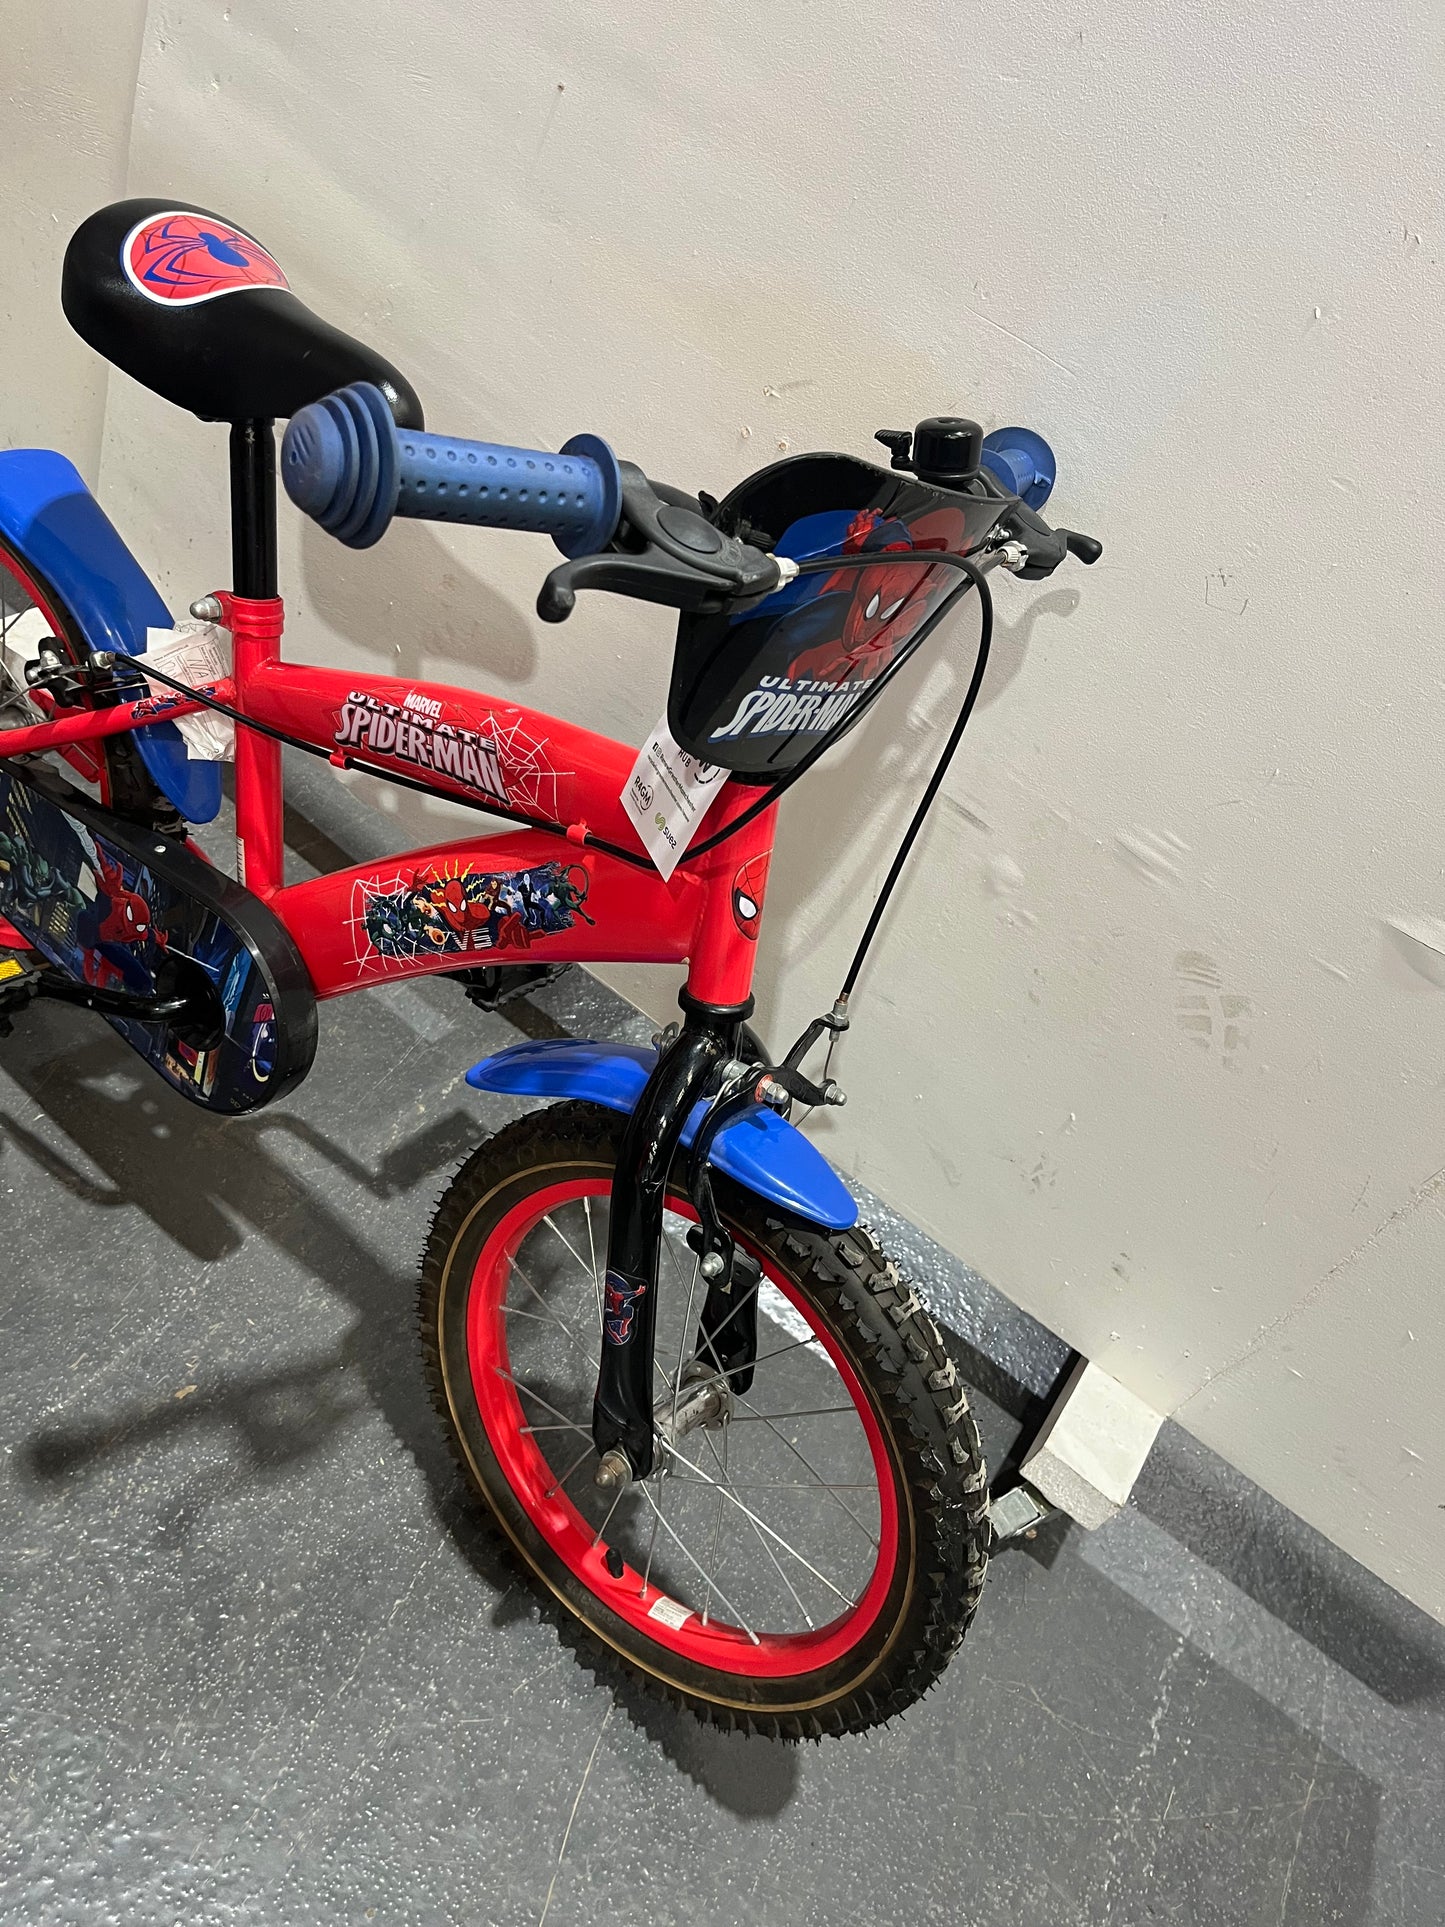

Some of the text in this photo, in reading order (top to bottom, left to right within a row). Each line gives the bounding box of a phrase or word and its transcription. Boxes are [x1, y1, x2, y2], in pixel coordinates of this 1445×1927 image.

[759, 675, 875, 693] ULTIMATE
[403, 690, 442, 717] MARVEL
[347, 691, 495, 750] ULTIMATE
[334, 703, 512, 804] SPIDER-MAN
[678, 748, 692, 768] HUB
